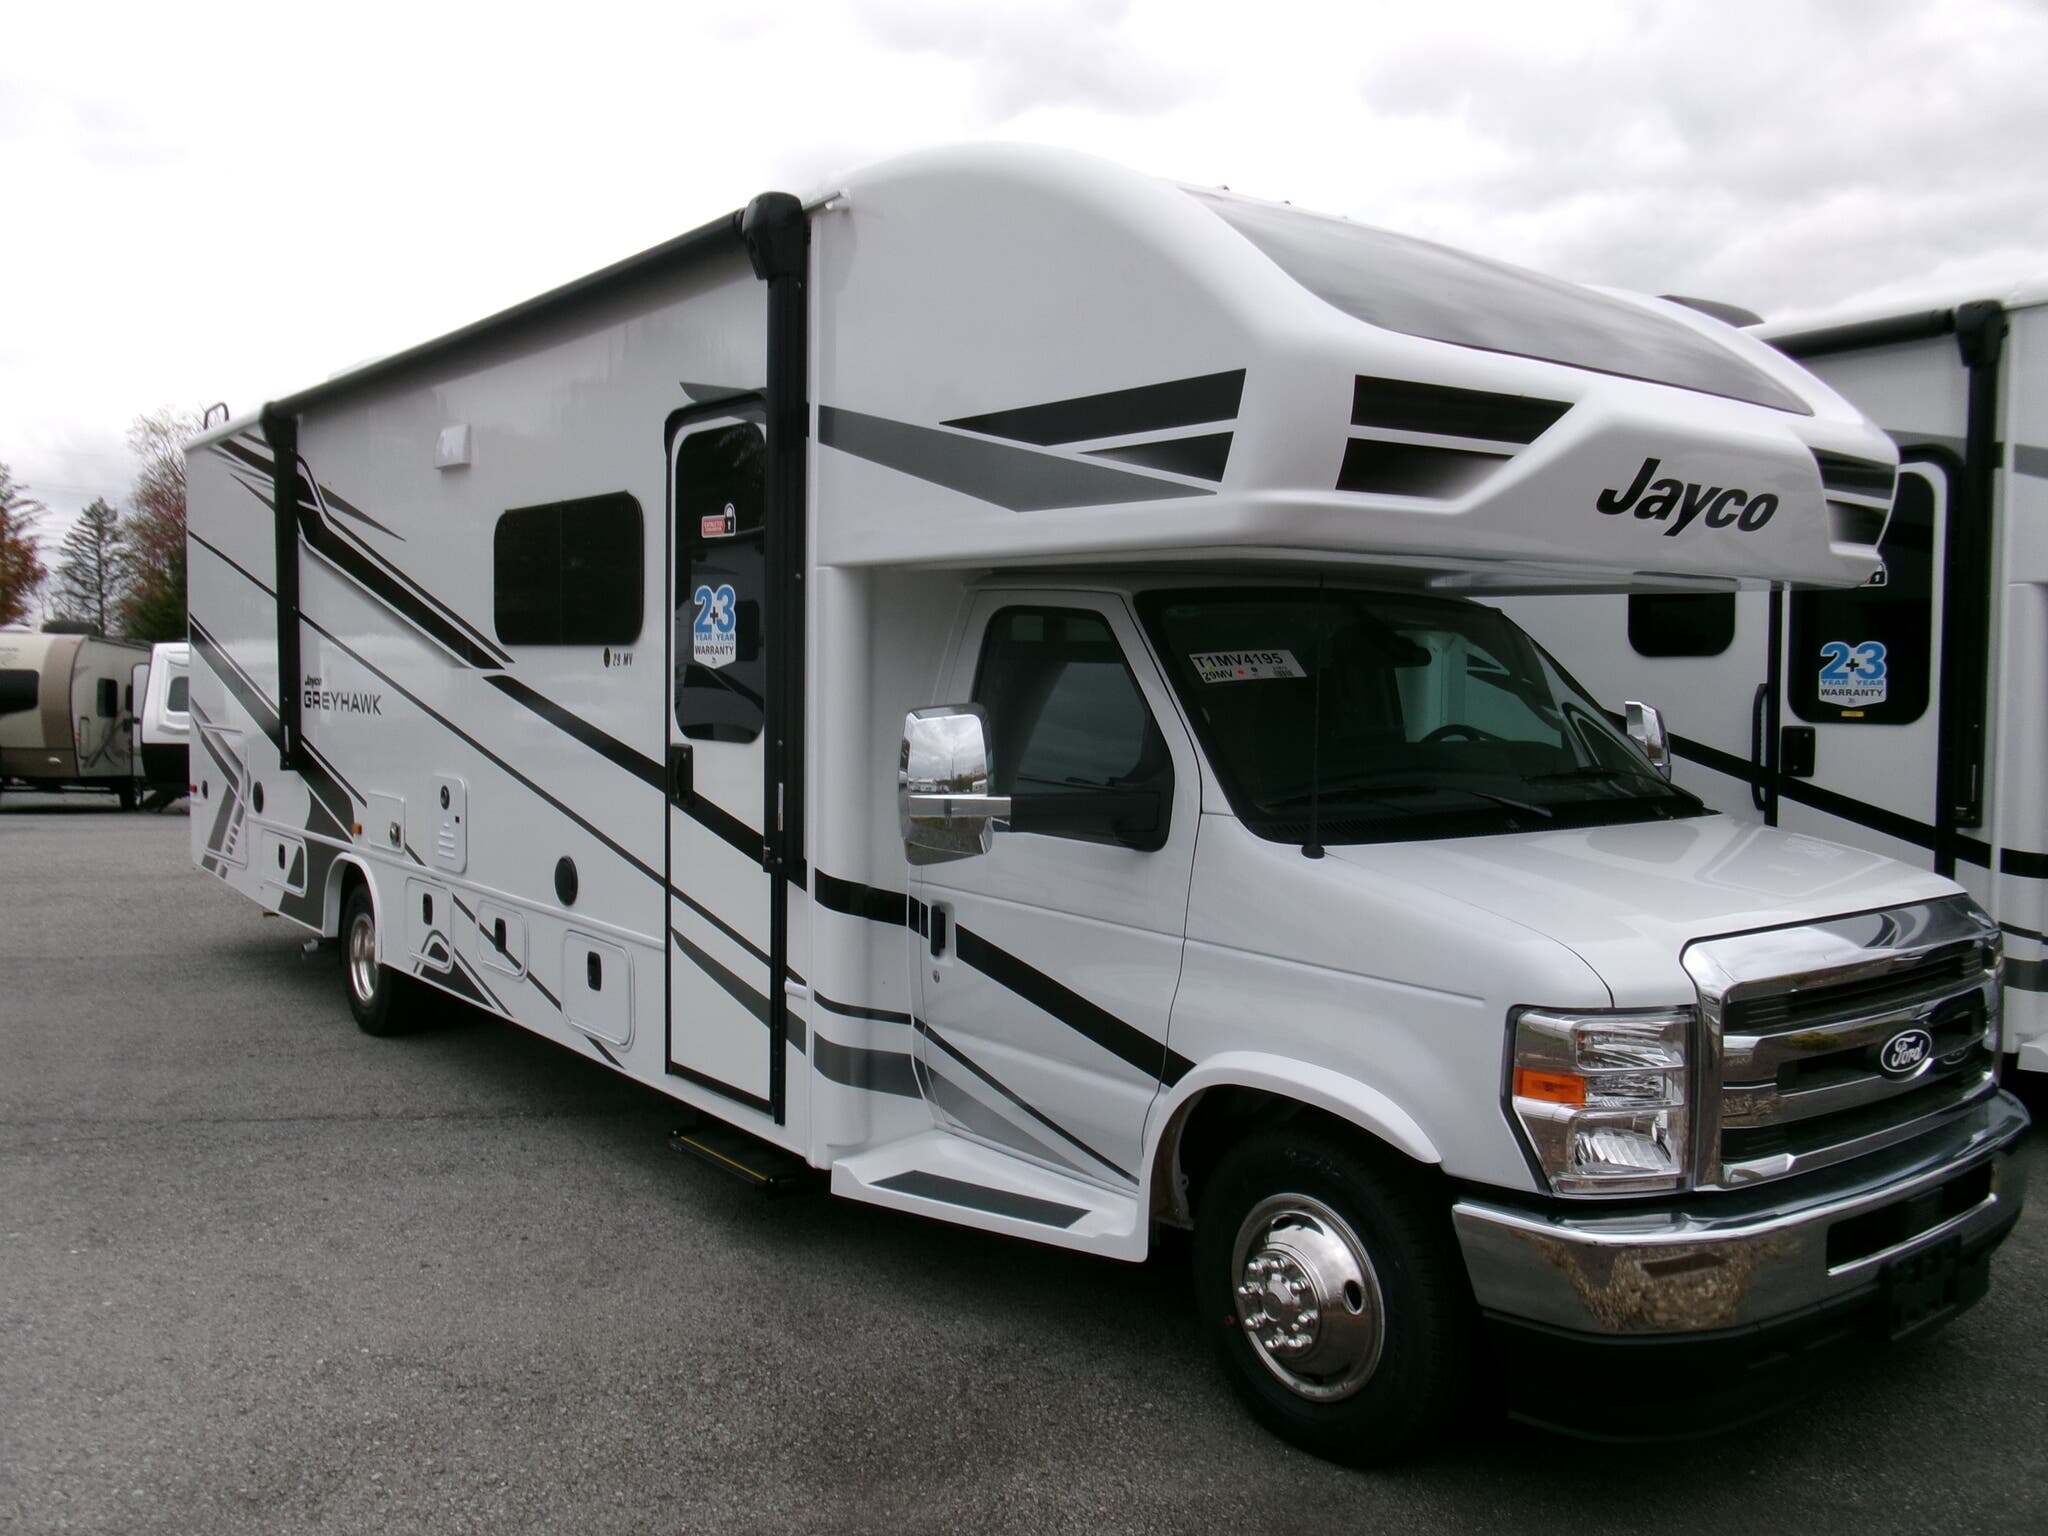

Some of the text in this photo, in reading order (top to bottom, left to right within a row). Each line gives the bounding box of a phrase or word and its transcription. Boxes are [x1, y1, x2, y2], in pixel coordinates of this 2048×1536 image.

[1596, 457, 1780, 537] Jayco
[696, 633, 735, 641] YEAR YEAR
[695, 645, 734, 655] WARRANTY
[1192, 652, 1284, 668] T1MV4195
[1820, 688, 1884, 697] WARRANTY
[304, 690, 382, 715] GREYHAWK
[1891, 1035, 1925, 1068] Ford
